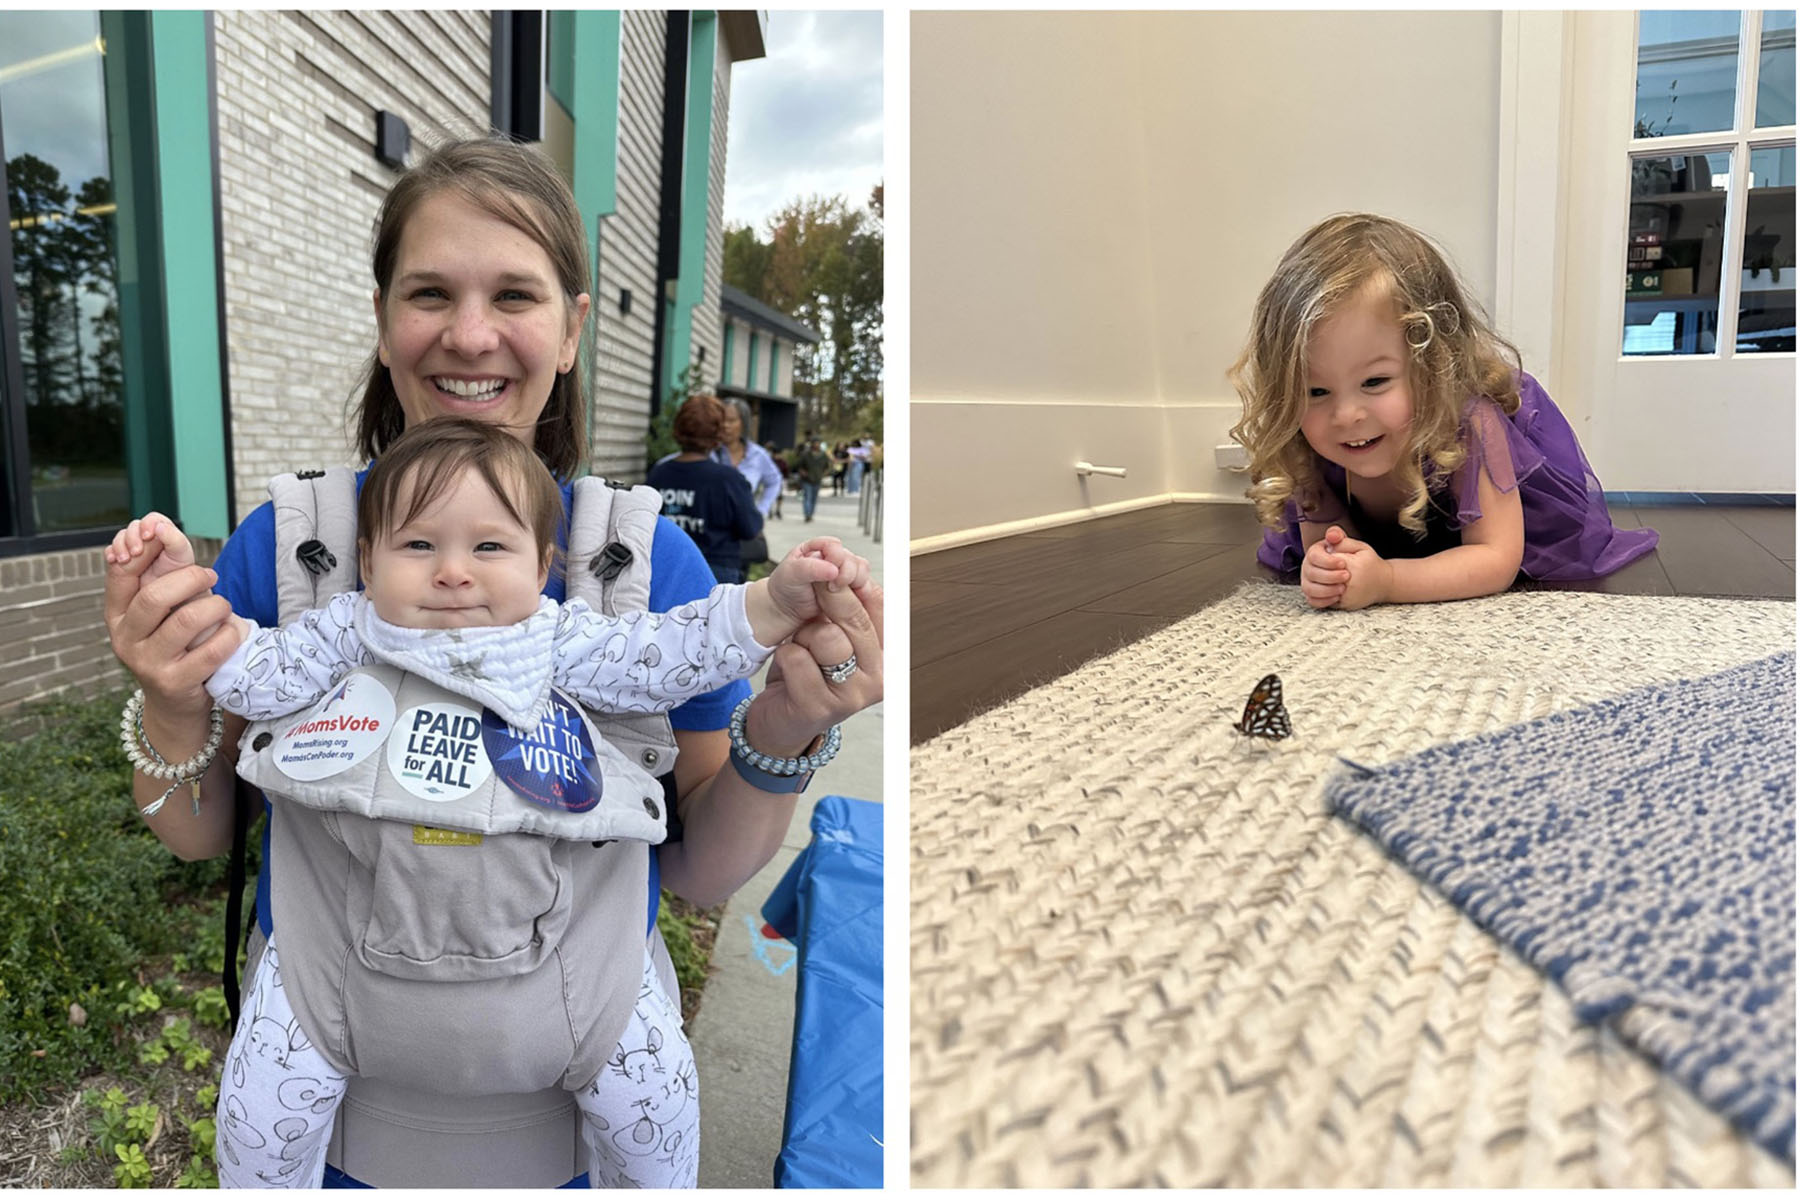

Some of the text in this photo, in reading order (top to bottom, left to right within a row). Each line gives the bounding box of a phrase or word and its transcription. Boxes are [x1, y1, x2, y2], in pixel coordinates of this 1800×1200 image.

[283, 715, 380, 740] #MomsVote
[412, 709, 481, 741] PAID
[292, 739, 349, 750] MomsRising.org
[407, 733, 478, 765] LEAVE
[561, 728, 583, 761] TO
[404, 755, 472, 789] for ALL
[519, 743, 579, 785] VOTE!
